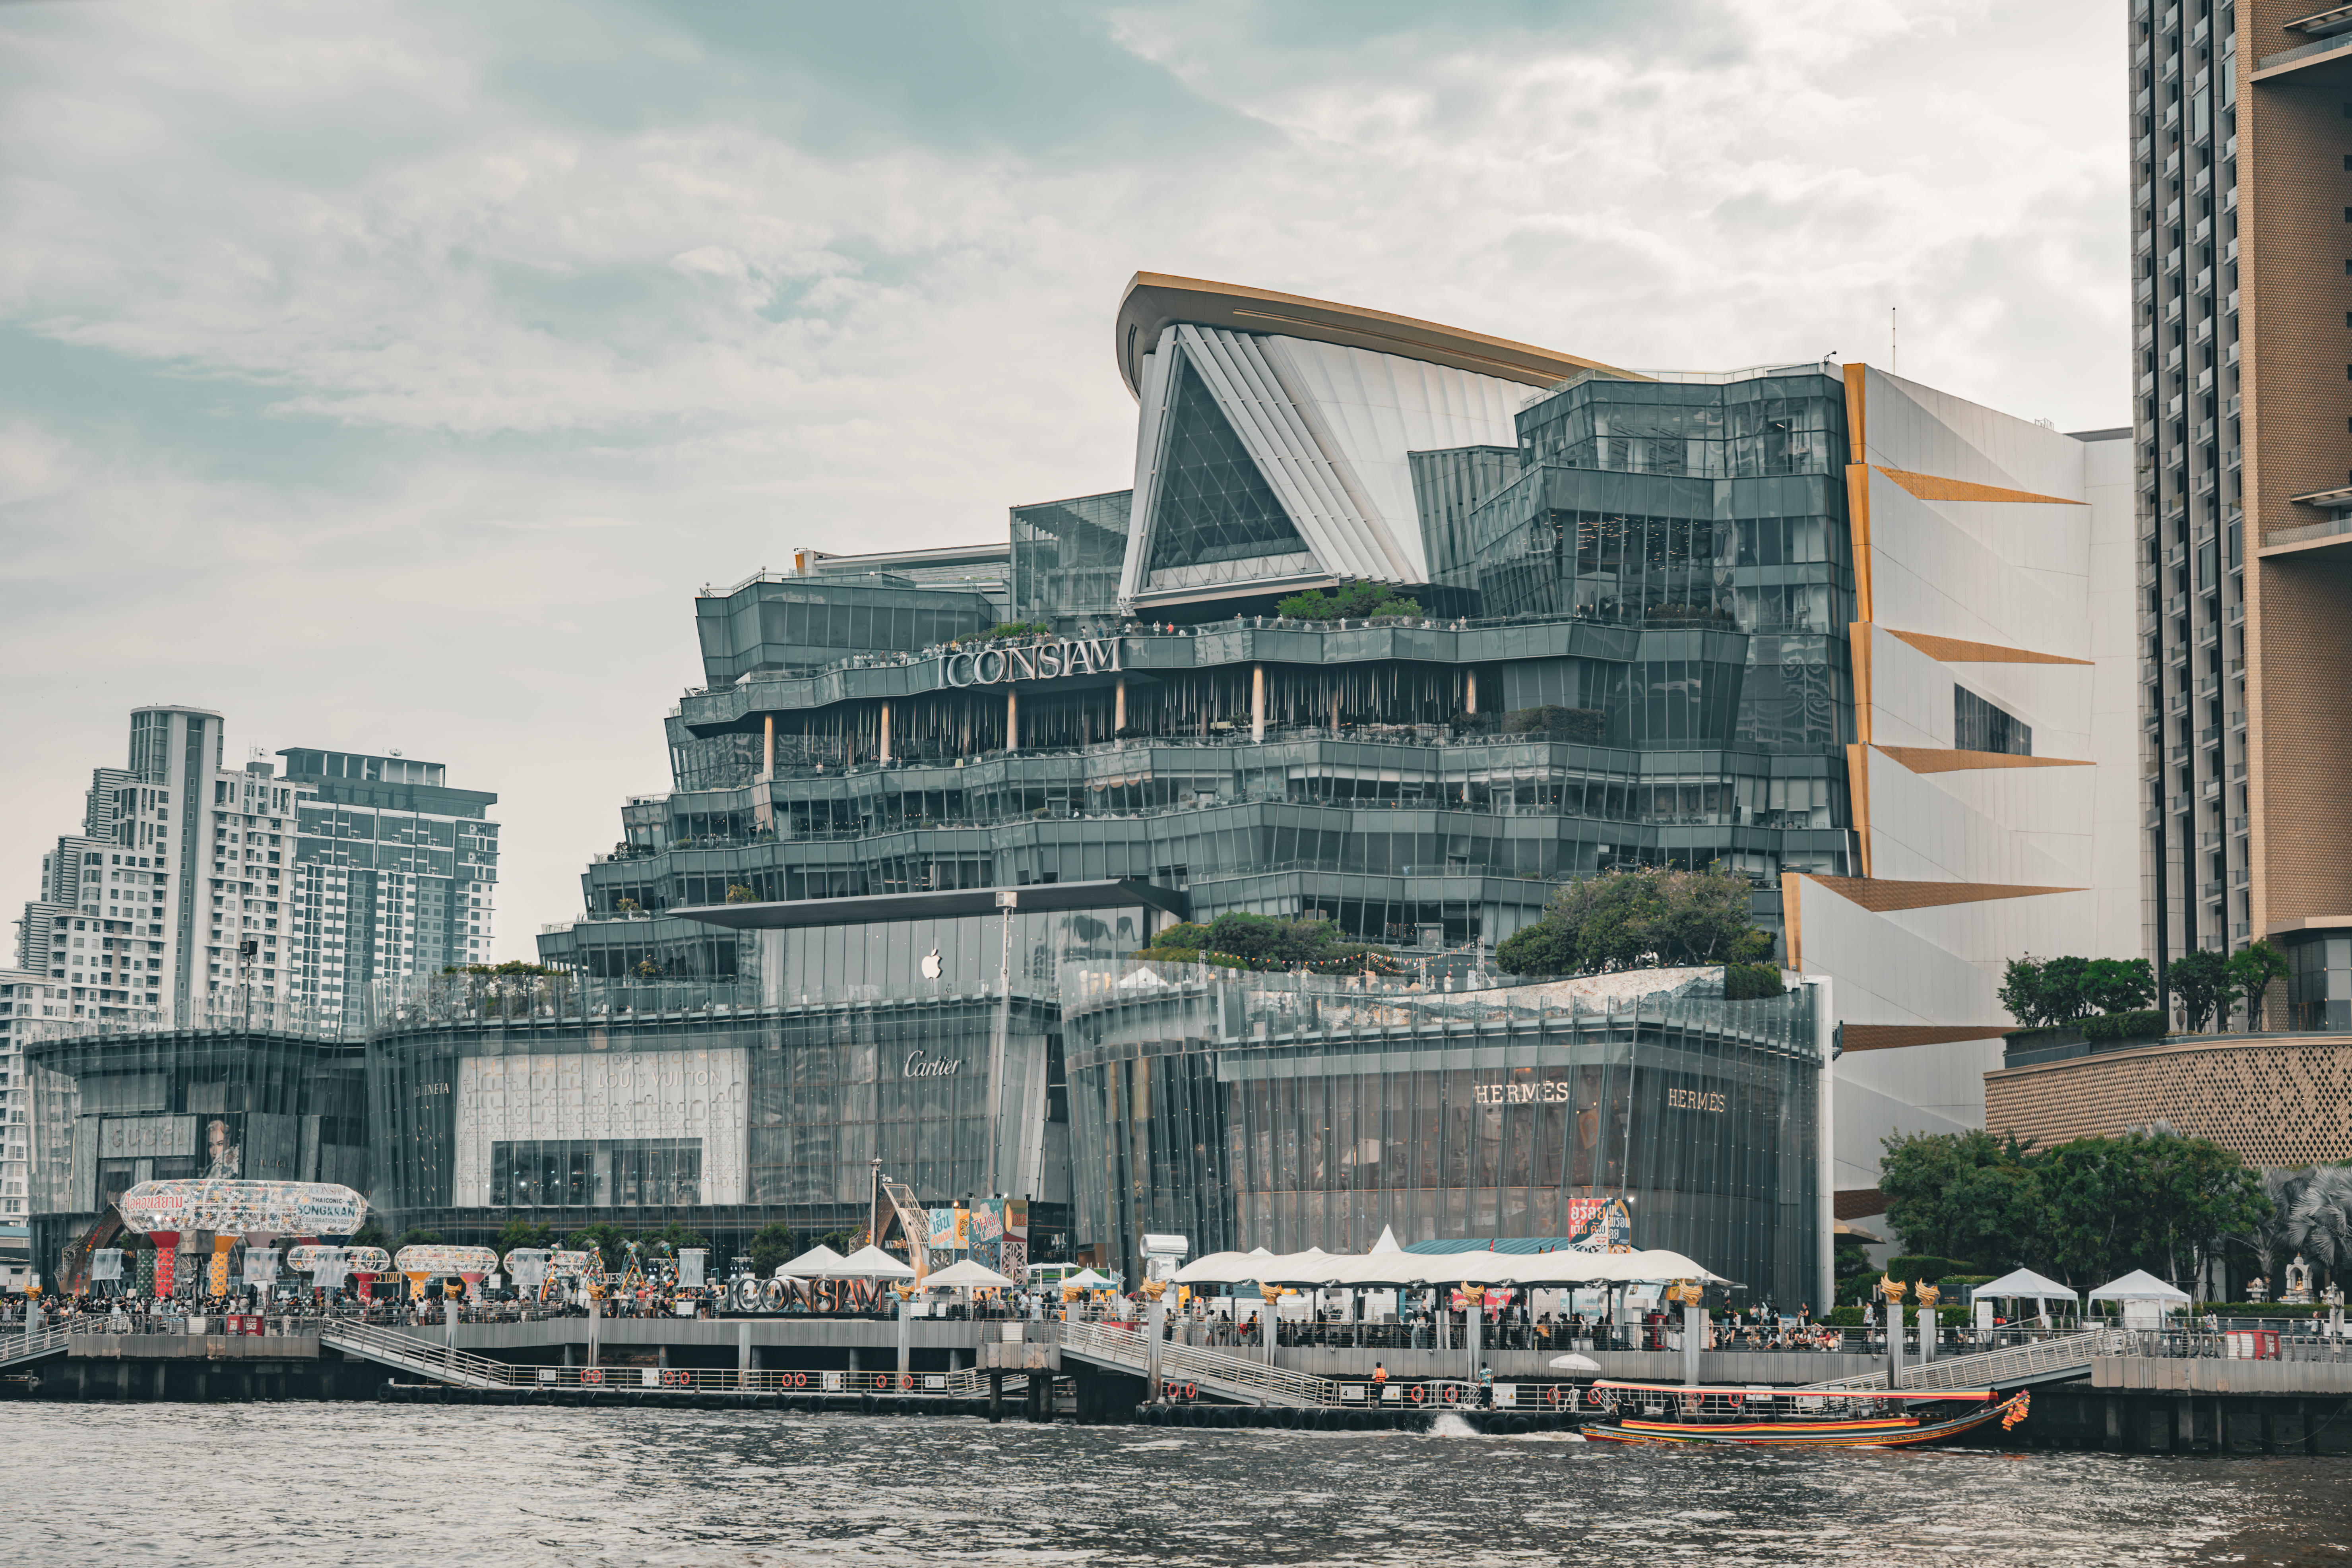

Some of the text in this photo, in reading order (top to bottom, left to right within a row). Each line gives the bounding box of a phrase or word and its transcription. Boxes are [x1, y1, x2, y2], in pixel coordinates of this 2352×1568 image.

[935, 637, 1122, 690] ICONSIAM
[905, 1050, 961, 1077] Cartier
[597, 1069, 721, 1088] LOUIS VUITTON
[112, 1127, 183, 1147] GUCCI
[252, 1159, 286, 1168] GUCCI
[126, 1193, 182, 1210] ไอคอนสยาม
[297, 1204, 355, 1217] SONGKRAN
[1571, 1200, 1606, 1220] อร่อย
[933, 1210, 950, 1234] เย็น
[971, 1210, 1001, 1234] THAI
[1609, 1212, 1630, 1228] พร้อม
[980, 1225, 1002, 1242] LAND
[1609, 1229, 1619, 1244] ลุย
[724, 1278, 887, 1312] ICONSIAM
